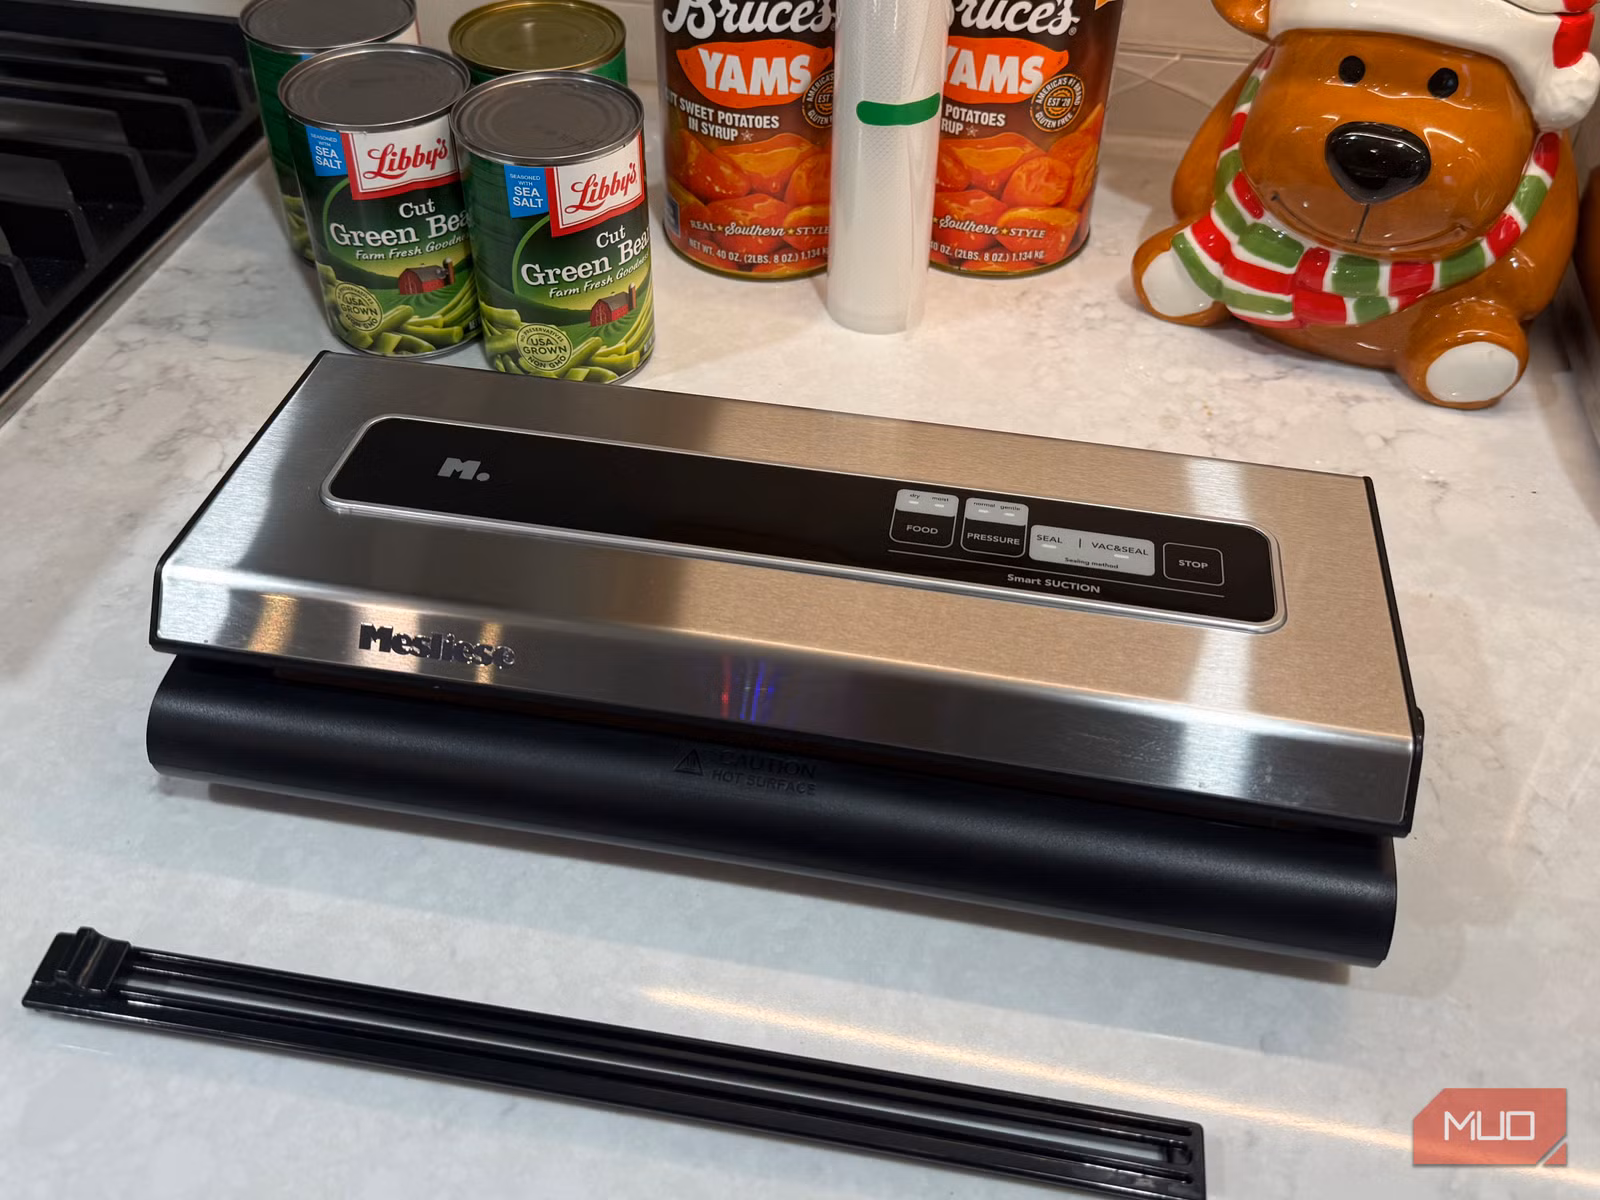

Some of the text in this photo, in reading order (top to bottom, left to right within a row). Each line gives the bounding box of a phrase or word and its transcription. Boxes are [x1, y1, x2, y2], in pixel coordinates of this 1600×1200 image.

[948, 0, 1080, 35] ruce's
[698, 48, 812, 96] YAMS
[1036, 77, 1068, 104] AMERICA'S
[1047, 98, 1060, 107] EST
[680, 97, 714, 122] SWEET
[717, 110, 780, 129] POTATOES
[807, 110, 829, 125] GLUTEN
[945, 104, 1006, 127] POTATOES
[1035, 111, 1073, 128] GLUTEN FREE
[688, 116, 739, 141] IN SYRUP
[941, 118, 964, 135] RUP
[315, 145, 339, 159] SEA
[362, 137, 449, 180] Libby's
[315, 155, 342, 169] SALT
[509, 173, 541, 181] SEASONED
[514, 186, 541, 197] SEA
[564, 162, 637, 214] Libby's
[399, 198, 436, 218] Cut
[512, 197, 543, 208] SALT
[330, 209, 469, 247] Green Bea
[690, 220, 716, 232] REAL
[724, 222, 785, 237] Southern
[939, 215, 1046, 239] Southern STYLE
[596, 224, 626, 248] Cut
[356, 249, 385, 261] Farm
[389, 245, 422, 259] Fresh
[520, 226, 649, 286] Green Bea
[716, 249, 727, 260] 40
[728, 251, 742, 262] OZ.
[983, 252, 989, 262] 8
[1012, 251, 1033, 262] 1.134
[549, 287, 580, 298] Farm
[583, 275, 613, 292] Fresh
[340, 304, 378, 316] GROWN
[345, 296, 366, 307] USA
[363, 318, 378, 329] GMO
[524, 327, 564, 342] PRESERVATIVES
[531, 338, 554, 346] USA
[523, 345, 567, 355] GROWN
[528, 355, 566, 368] NON GMO
[906, 524, 939, 535] FOOD
[967, 532, 1021, 546] PRESSURE
[1036, 534, 1149, 556] SEAL VAC&SEAL
[1064, 557, 1119, 569] Sealing method
[1178, 559, 1209, 569] STOP
[1007, 573, 1101, 594] Smart SUCTION
[359, 622, 516, 666] Mesliese
[720, 749, 817, 779] CAUTION
[711, 769, 817, 796] HOT SURFACE
